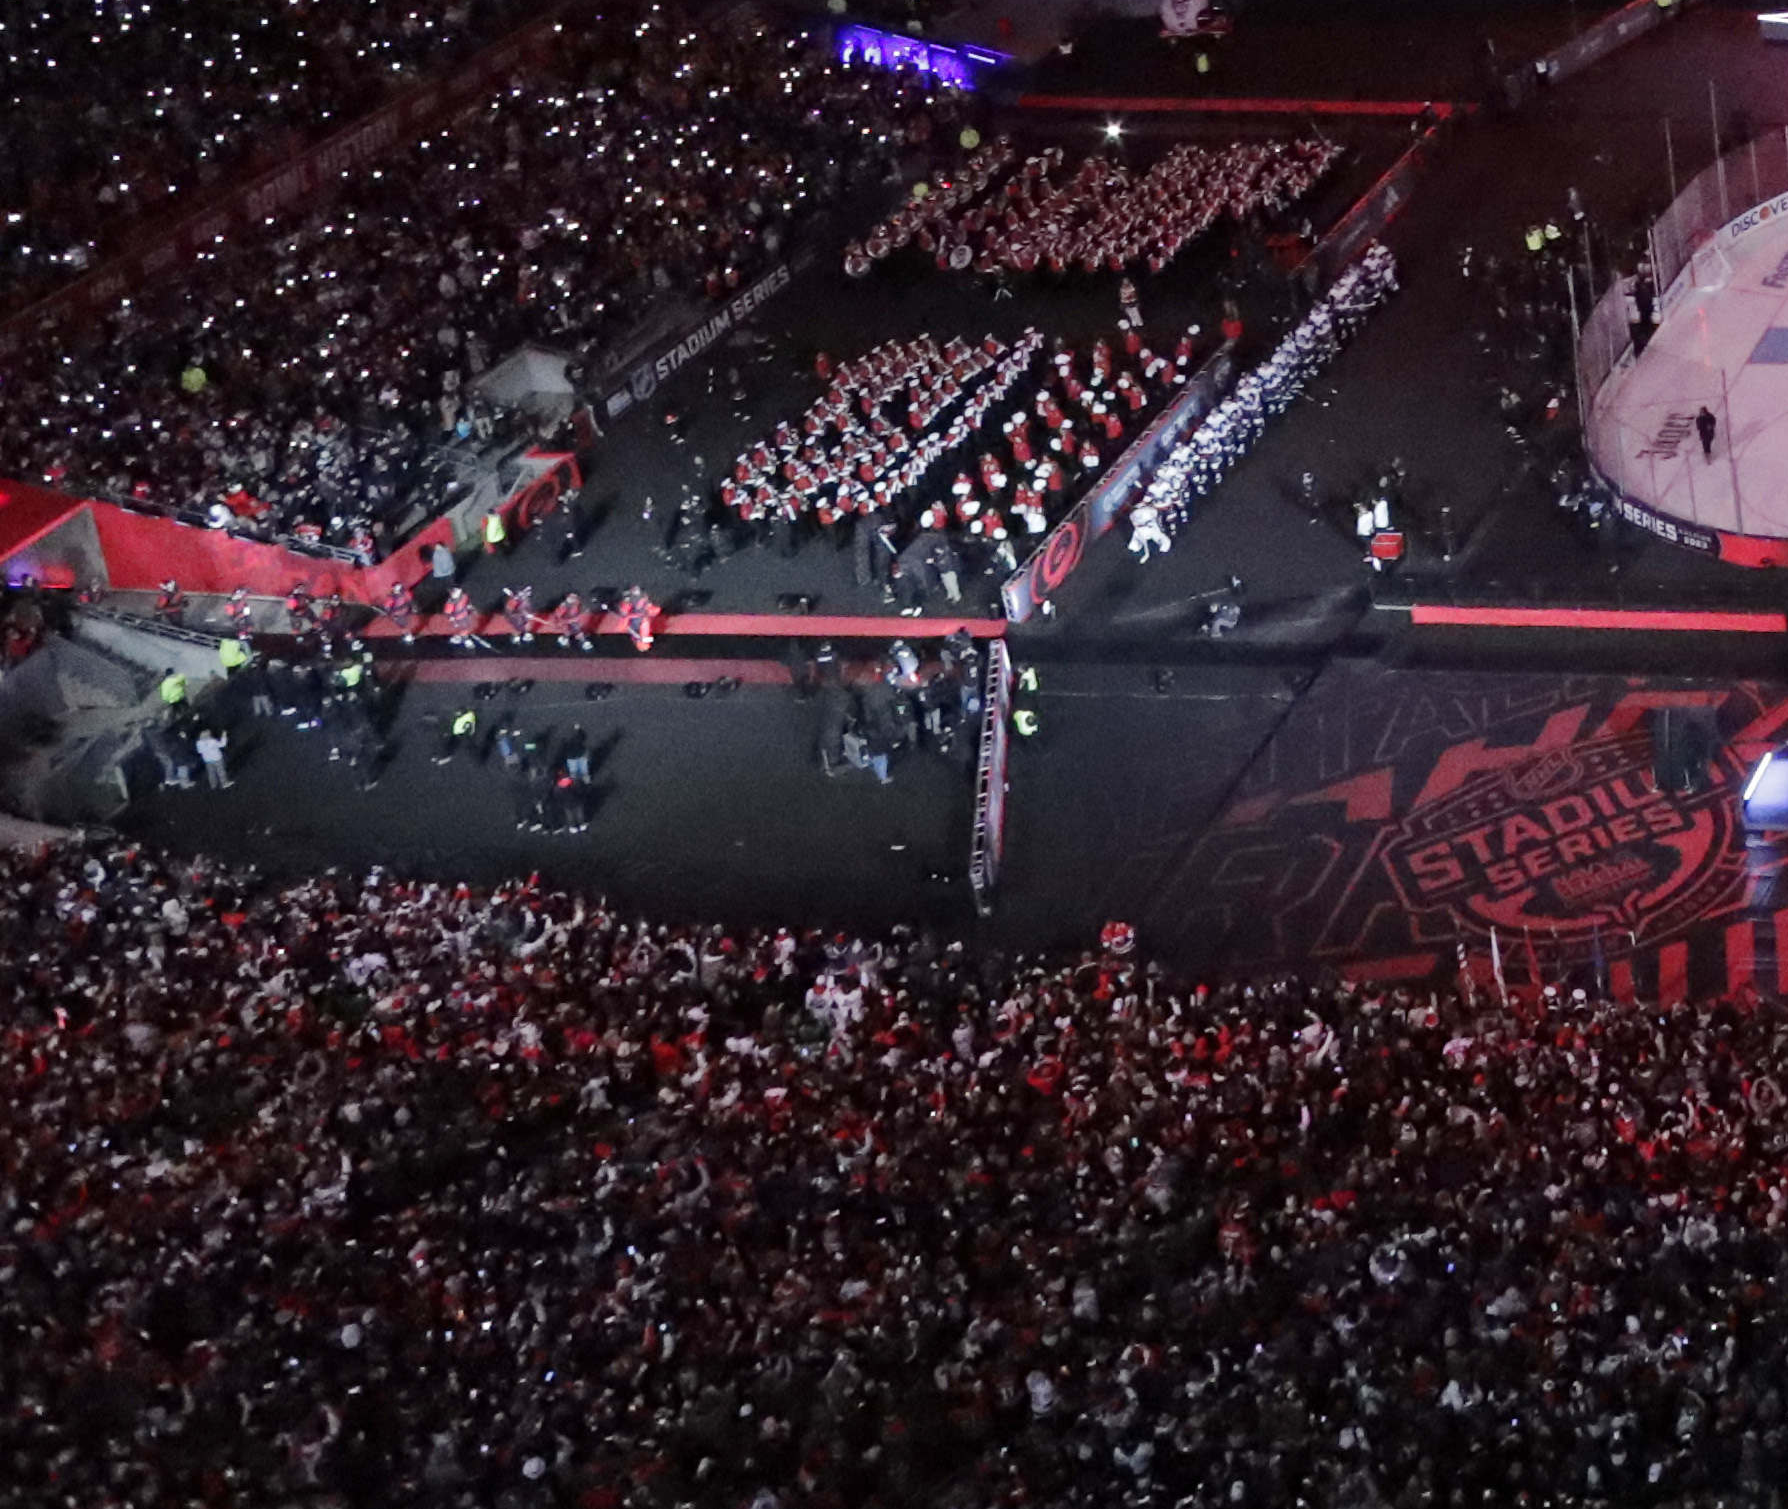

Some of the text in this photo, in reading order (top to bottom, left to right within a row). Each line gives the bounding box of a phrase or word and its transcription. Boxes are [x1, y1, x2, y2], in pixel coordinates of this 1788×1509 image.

[655, 264, 791, 381] STADIUM SERIES
[1623, 502, 1678, 542] SERIES
[1487, 803, 1684, 892] SERIES
